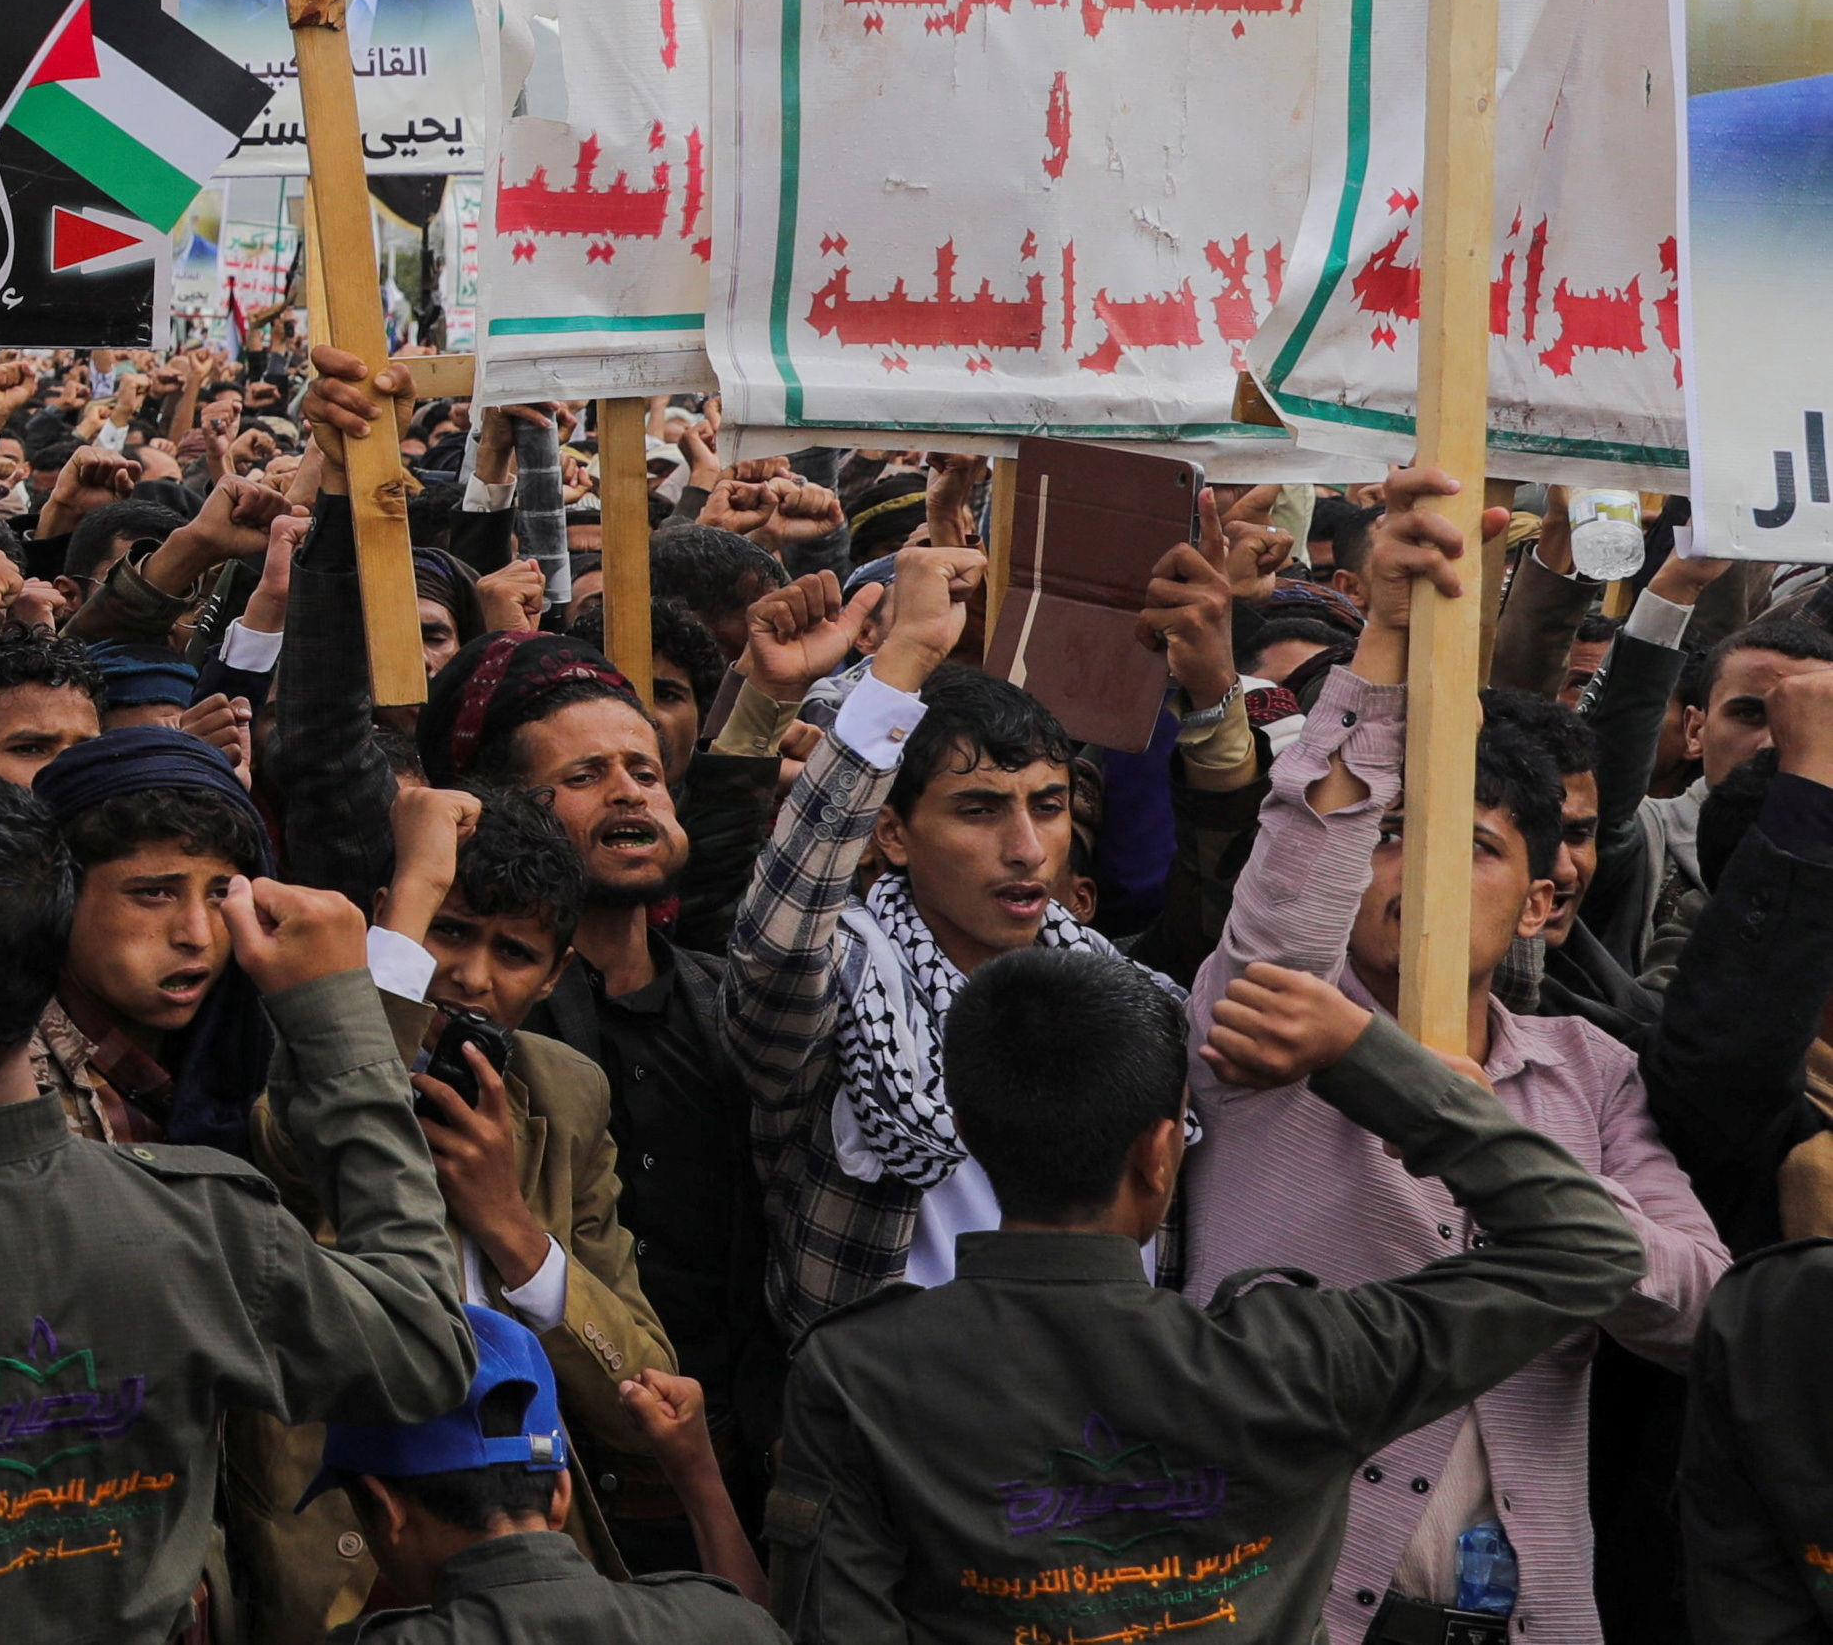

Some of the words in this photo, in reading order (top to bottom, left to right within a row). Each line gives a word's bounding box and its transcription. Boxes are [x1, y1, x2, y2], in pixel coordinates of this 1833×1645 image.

[352, 46, 427, 79] القائ
[361, 115, 464, 159] يحيى
[1043, 70, 1072, 183] و
[87, 1470, 175, 1508] مدارس
[45, 1528, 122, 1562] بناء
[1187, 1535, 1273, 1581] مدارس
[960, 1568, 1071, 1601] التربوية
[1073, 1556, 1181, 1594] البصيرة
[1151, 1598, 1237, 1635] بناء
